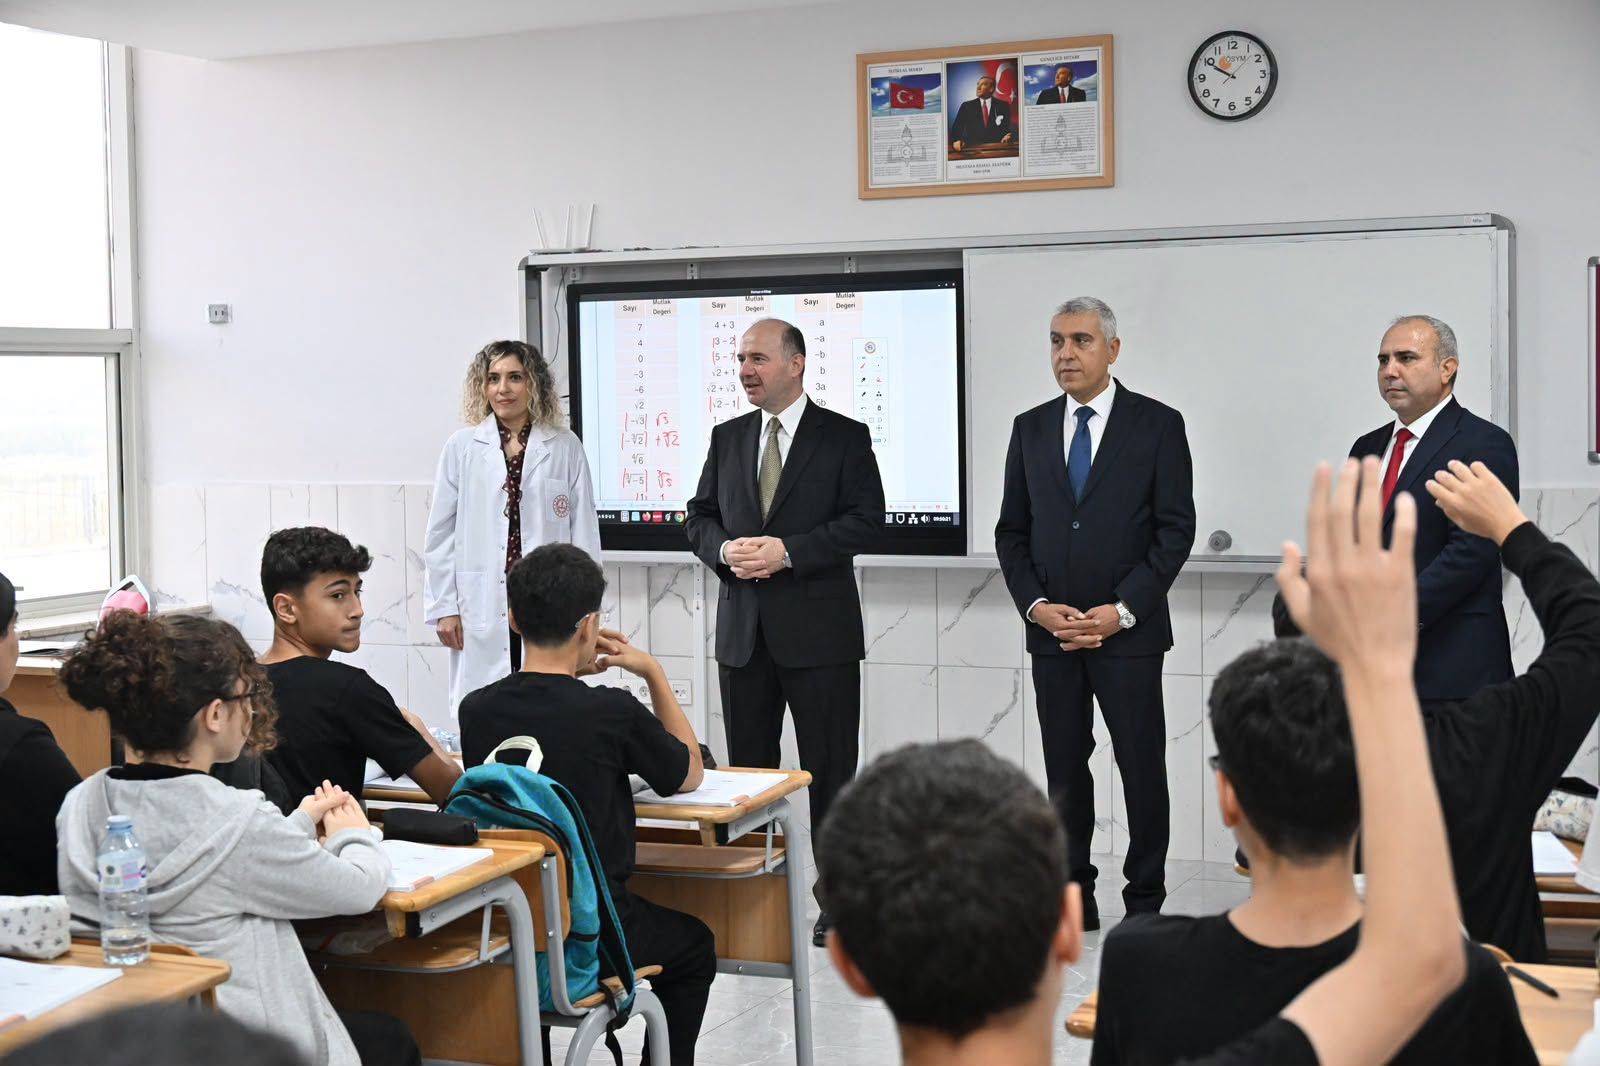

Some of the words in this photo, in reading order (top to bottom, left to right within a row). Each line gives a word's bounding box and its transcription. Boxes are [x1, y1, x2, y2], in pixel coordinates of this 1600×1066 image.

[1227, 40, 1239, 51] 12
[1214, 46, 1222, 55] 11
[1204, 57, 1215, 67] 10
[1254, 54, 1262, 63] 2
[1198, 73, 1206, 83] 9
[1259, 69, 1267, 79] 3
[1202, 88, 1211, 98] 8
[1254, 85, 1263, 95] 4
[1212, 98, 1220, 108] 7
[1244, 96, 1252, 106] 5
[1228, 101, 1237, 111] 6
[711, 302, 727, 310] Sayı
[803, 298, 819, 306] Sayı
[622, 304, 637, 312] Sayı
[637, 323, 643, 331] 7
[714, 321, 720, 329] 4
[729, 320, 735, 329] 3
[637, 339, 643, 347] 4
[633, 370, 644, 378] -3
[820, 366, 826, 374] b
[634, 385, 645, 394] -6
[815, 382, 826, 391] 3a
